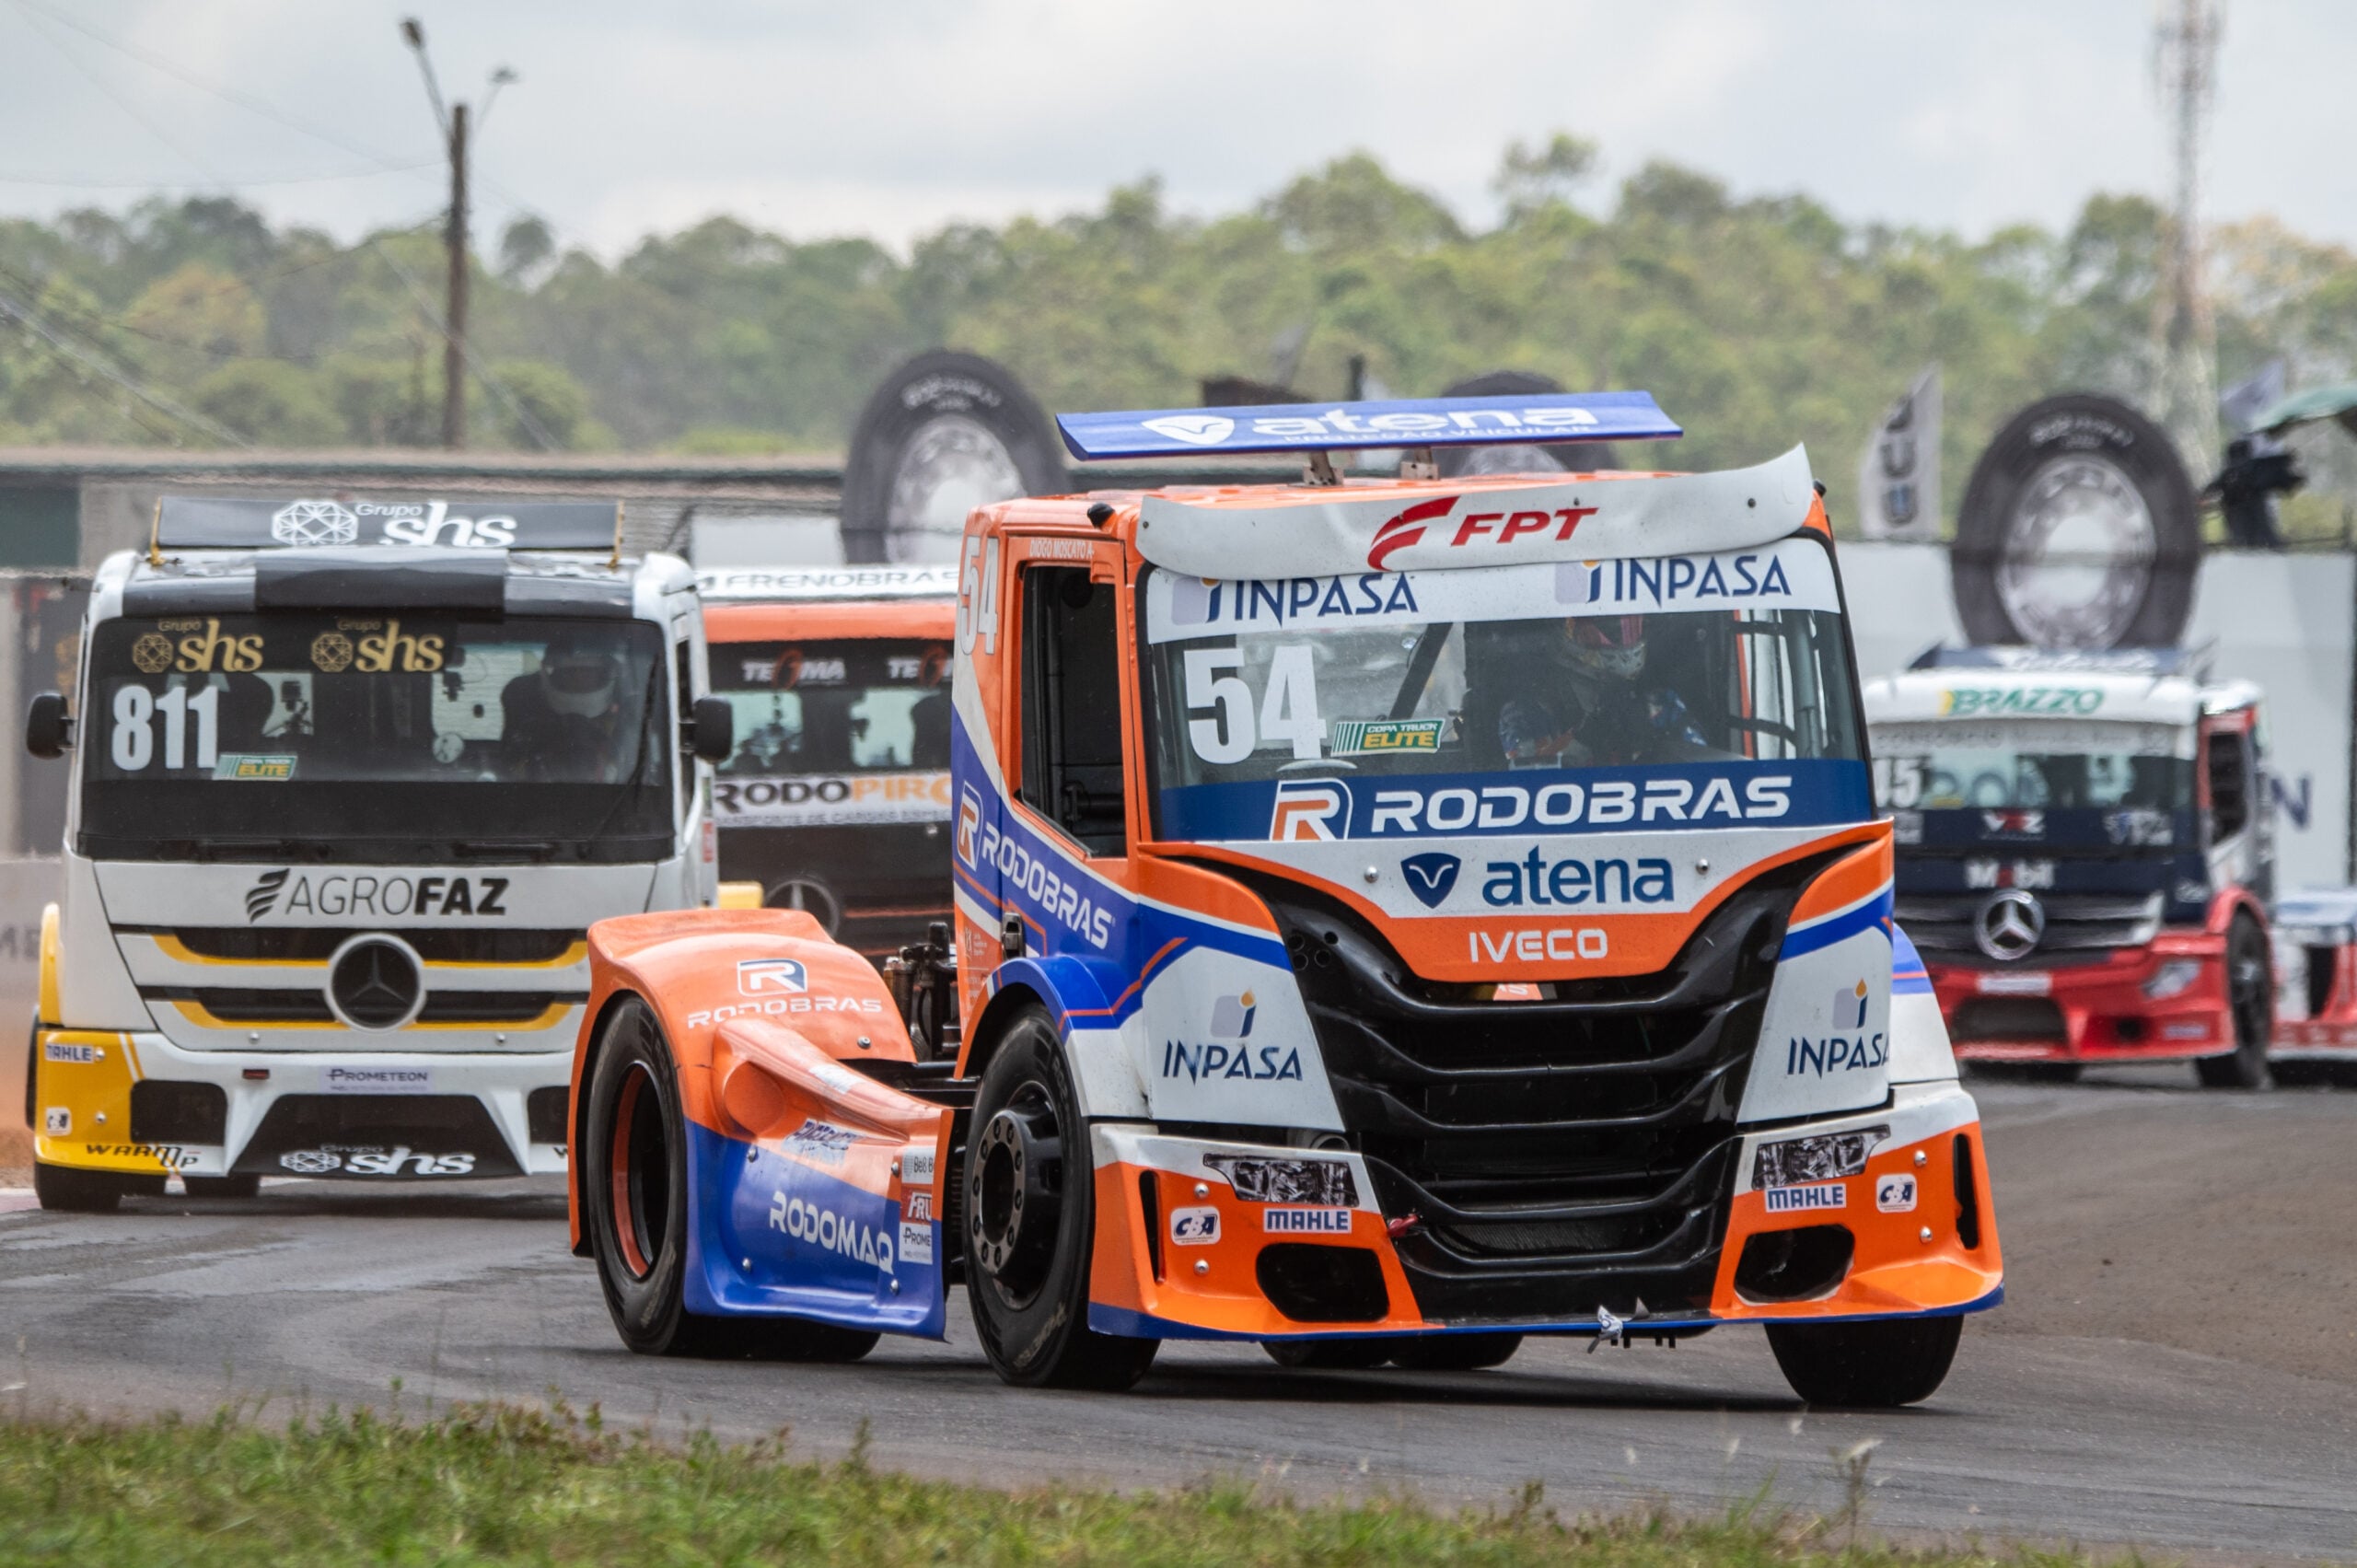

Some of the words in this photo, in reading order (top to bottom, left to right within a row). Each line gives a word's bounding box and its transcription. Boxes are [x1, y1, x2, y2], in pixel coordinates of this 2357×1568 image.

[1252, 408, 1599, 436] atena
[354, 503, 423, 517] Grupo
[379, 501, 517, 547] shs
[1450, 505, 1599, 546] FPT
[958, 535, 1000, 656] 54
[1234, 571, 1420, 627] INPASA
[1614, 554, 1793, 607] INPASA
[157, 618, 202, 633] Grupo
[176, 618, 264, 673] shs
[337, 618, 381, 633] Grupo
[354, 620, 445, 673] shs
[1184, 645, 1328, 764] 54
[1950, 689, 2105, 714] BRAZZO
[111, 685, 219, 772] 811
[1364, 731, 1435, 749] ELITE
[1366, 726, 1398, 734] COPA
[1399, 723, 1438, 733] TRUCK
[238, 766, 289, 778] ELITE
[1371, 777, 1793, 833] RODOBRAS
[284, 876, 509, 916] AGROFAZ
[982, 822, 1112, 950] RODOBRAS
[1481, 845, 1675, 907] atena
[1469, 928, 1608, 963] IVECO
[687, 996, 884, 1029] RODOBRAS
[1162, 1040, 1304, 1086] INPASA
[344, 1144, 476, 1175] shs
[913, 1156, 926, 1173] Be8
[1768, 1186, 1844, 1210] MAHLE
[770, 1191, 894, 1274] RODOMAQ
[1267, 1211, 1349, 1231] MAHLE
